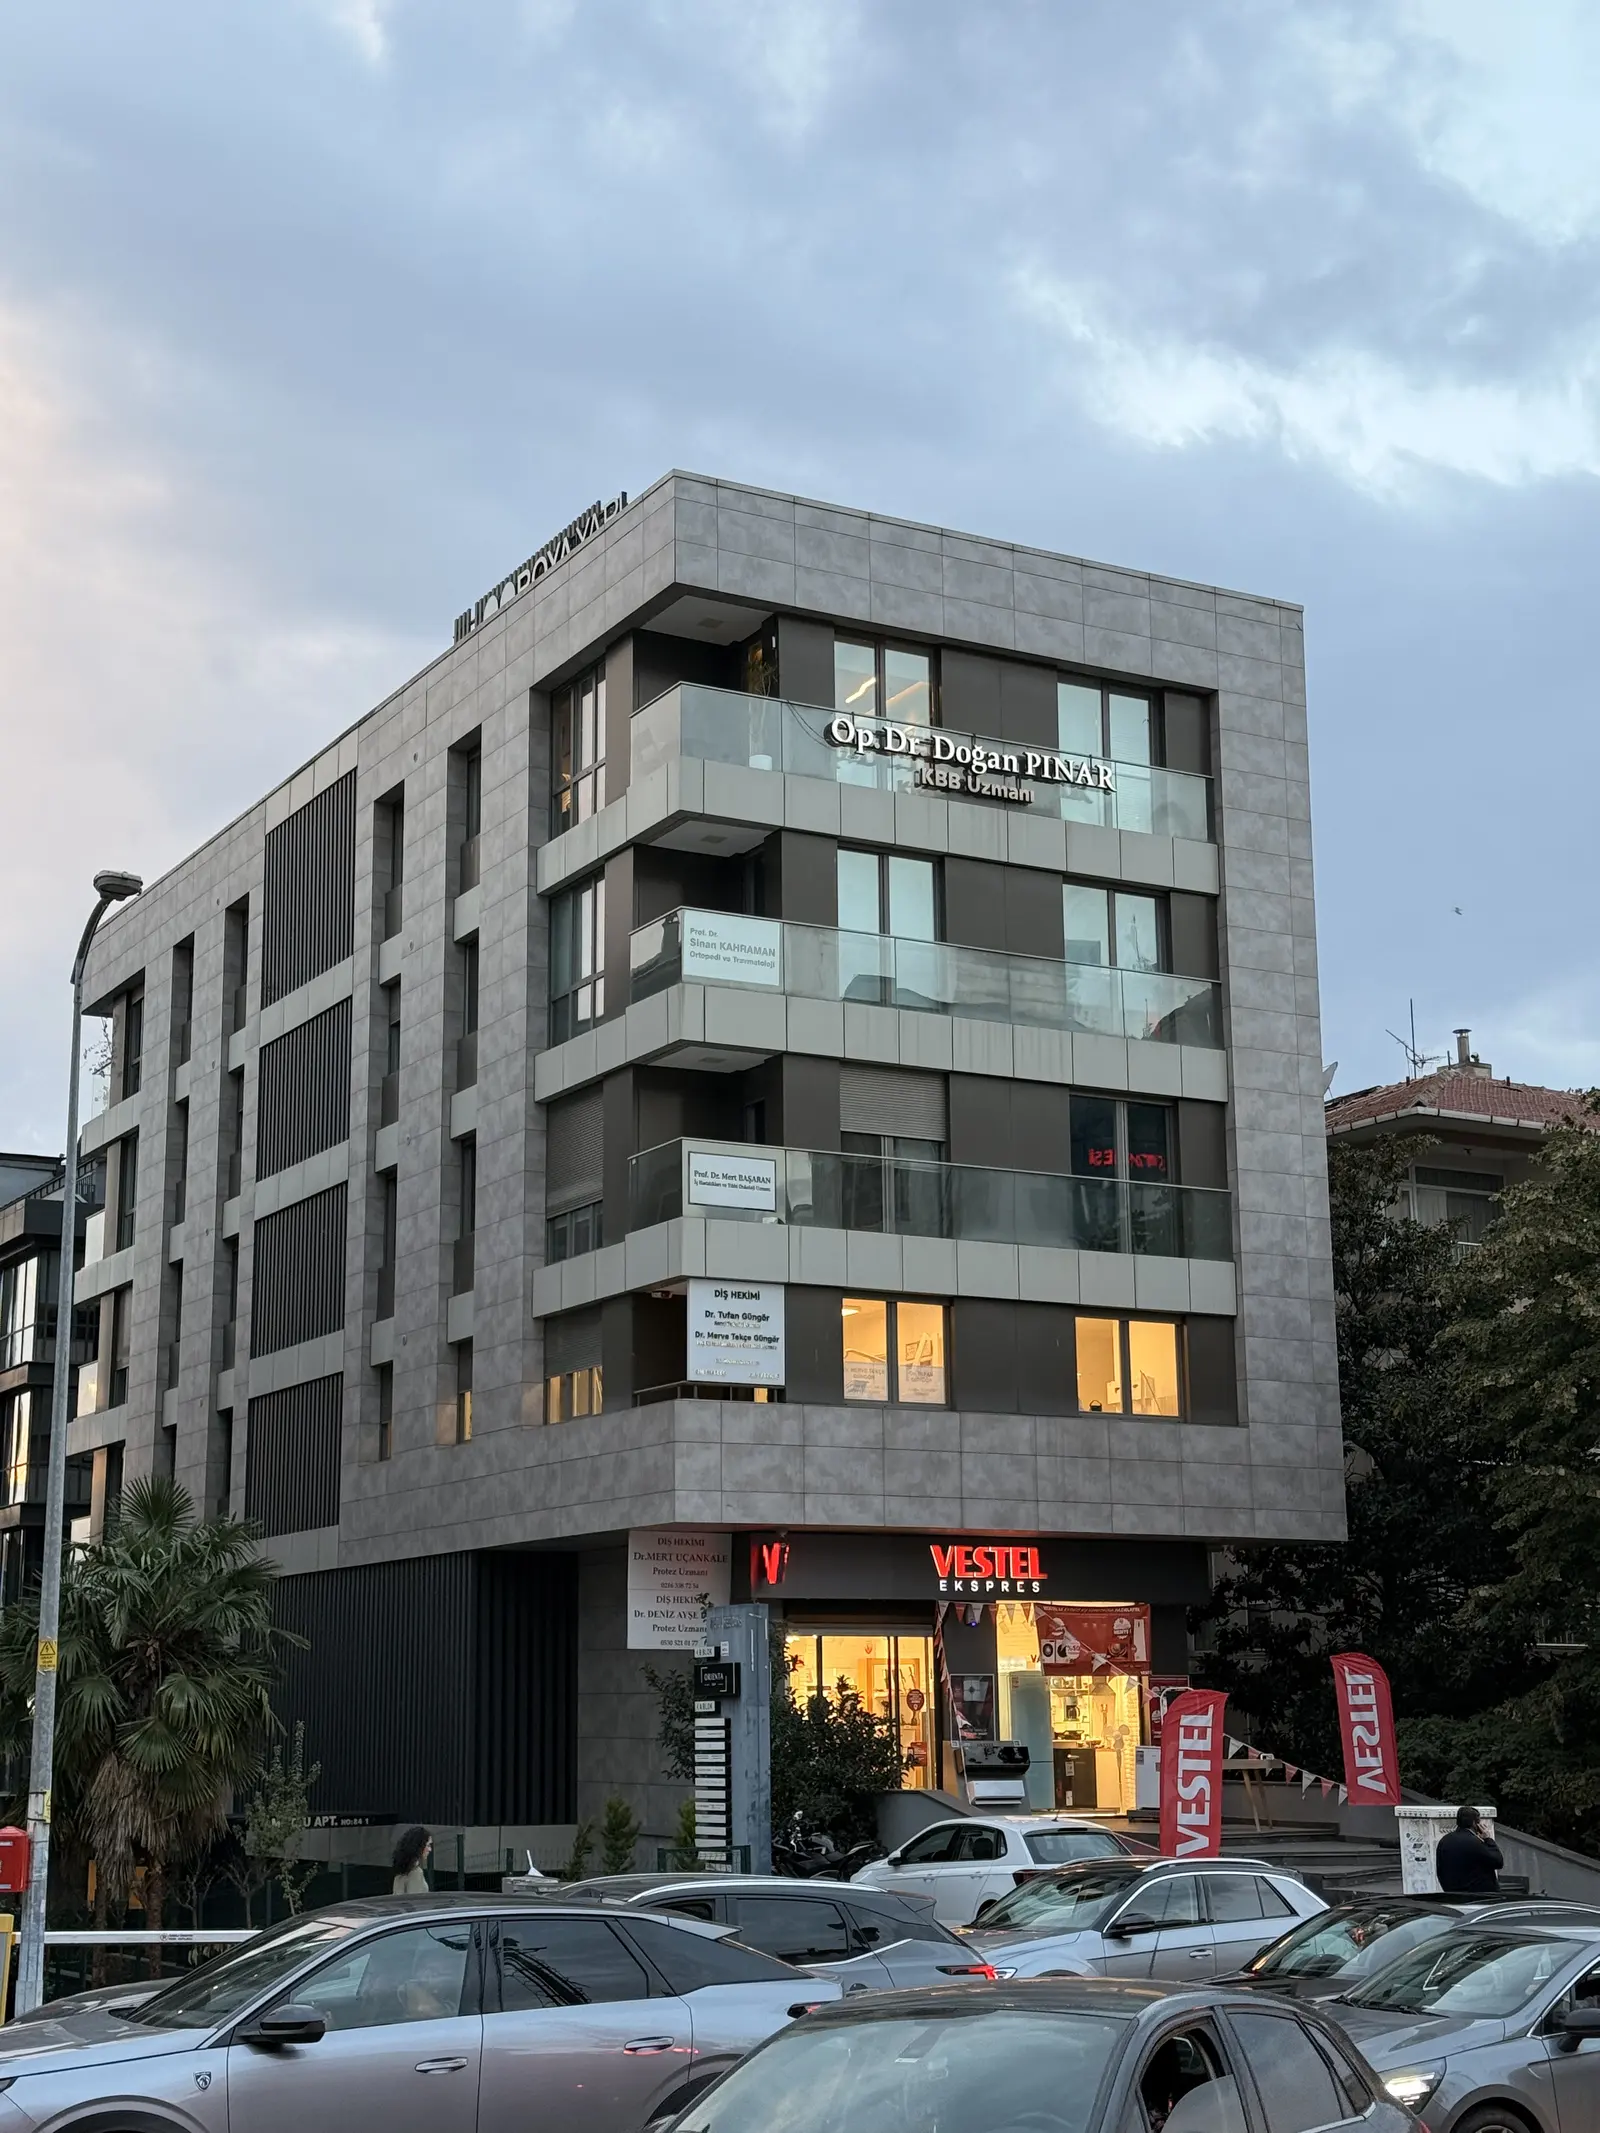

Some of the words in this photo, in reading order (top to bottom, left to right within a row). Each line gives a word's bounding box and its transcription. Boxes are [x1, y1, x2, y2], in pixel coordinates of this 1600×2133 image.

[830, 718, 880, 755] Op.
[882, 725, 920, 756] Dr.
[932, 734, 1019, 774] Doğan
[1022, 751, 1117, 792] PINAR
[920, 766, 961, 790] KBB
[967, 772, 1035, 803] Uzmanı
[690, 938, 717, 950] Sinan
[720, 942, 776, 957] KAHRAMAN
[690, 950, 721, 960] Ortopedi
[694, 1170, 709, 1178] Prof.
[722, 1172, 738, 1181] Mert
[714, 1288, 728, 1300] DİŞ
[731, 1290, 760, 1300] HEKİMİ
[705, 1310, 716, 1318] Dr.
[718, 1311, 740, 1320] Tufan
[742, 1312, 770, 1322] Güngör
[707, 1332, 729, 1340] Merve
[731, 1333, 751, 1342] Tekçe
[754, 1334, 780, 1344] Güngör
[658, 1537, 672, 1547] DİŞ
[674, 1538, 704, 1546] HEKİMİ
[930, 1544, 1048, 1579] VESTEL
[653, 1567, 676, 1576] Protez
[679, 1568, 708, 1576] Uzmanı
[939, 1580, 1040, 1593] EKSPRES
[656, 1594, 671, 1605] DİŞ
[673, 1595, 702, 1604] HEKİM
[634, 1610, 645, 1618] Dr.
[648, 1610, 675, 1618] DENİZ
[678, 1611, 698, 1620] AYŞE
[1176, 1704, 1214, 1858] VESTEL
[314, 1816, 338, 1827] APT.
